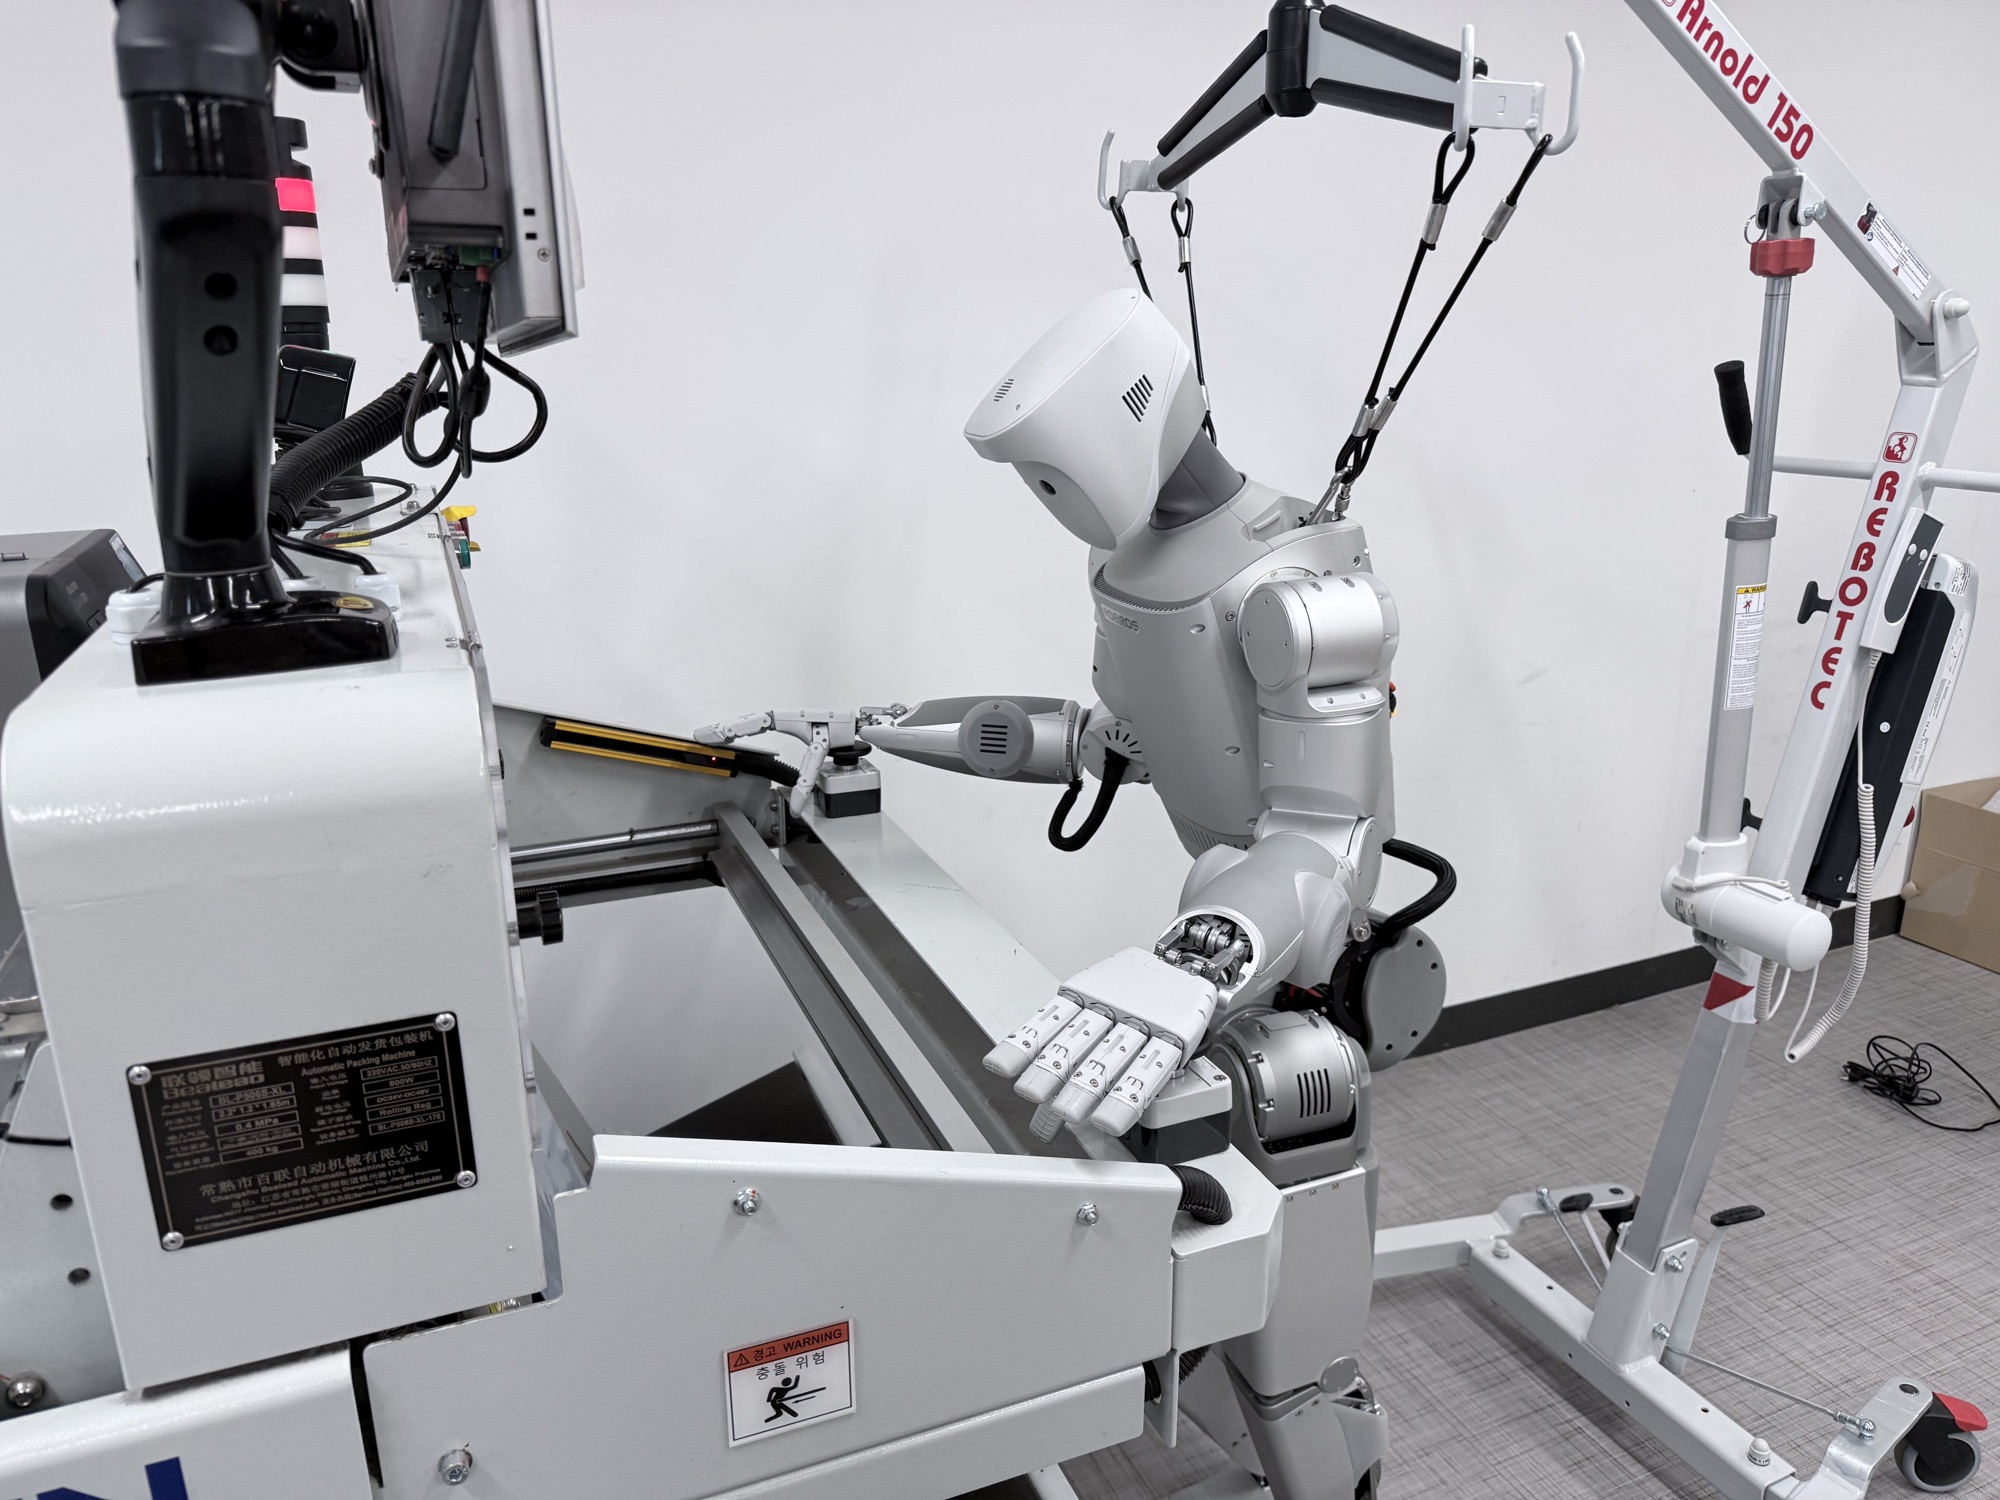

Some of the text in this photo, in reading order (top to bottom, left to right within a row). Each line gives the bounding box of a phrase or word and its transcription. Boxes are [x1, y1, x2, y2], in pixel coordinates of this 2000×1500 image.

[1677, 0, 1814, 160] Arnold 150
[1810, 470, 1900, 710] REBOTEC
[301, 1049, 416, 1077] Automatic Packing Machine
[235, 1117, 279, 1132] 0.4 MPa
[379, 1101, 433, 1119] Rolling Bag
[246, 1145, 280, 1156] 400 kg
[754, 1329, 842, 1361] 경고 WARNING
[756, 1350, 825, 1380] 충돌 위험
